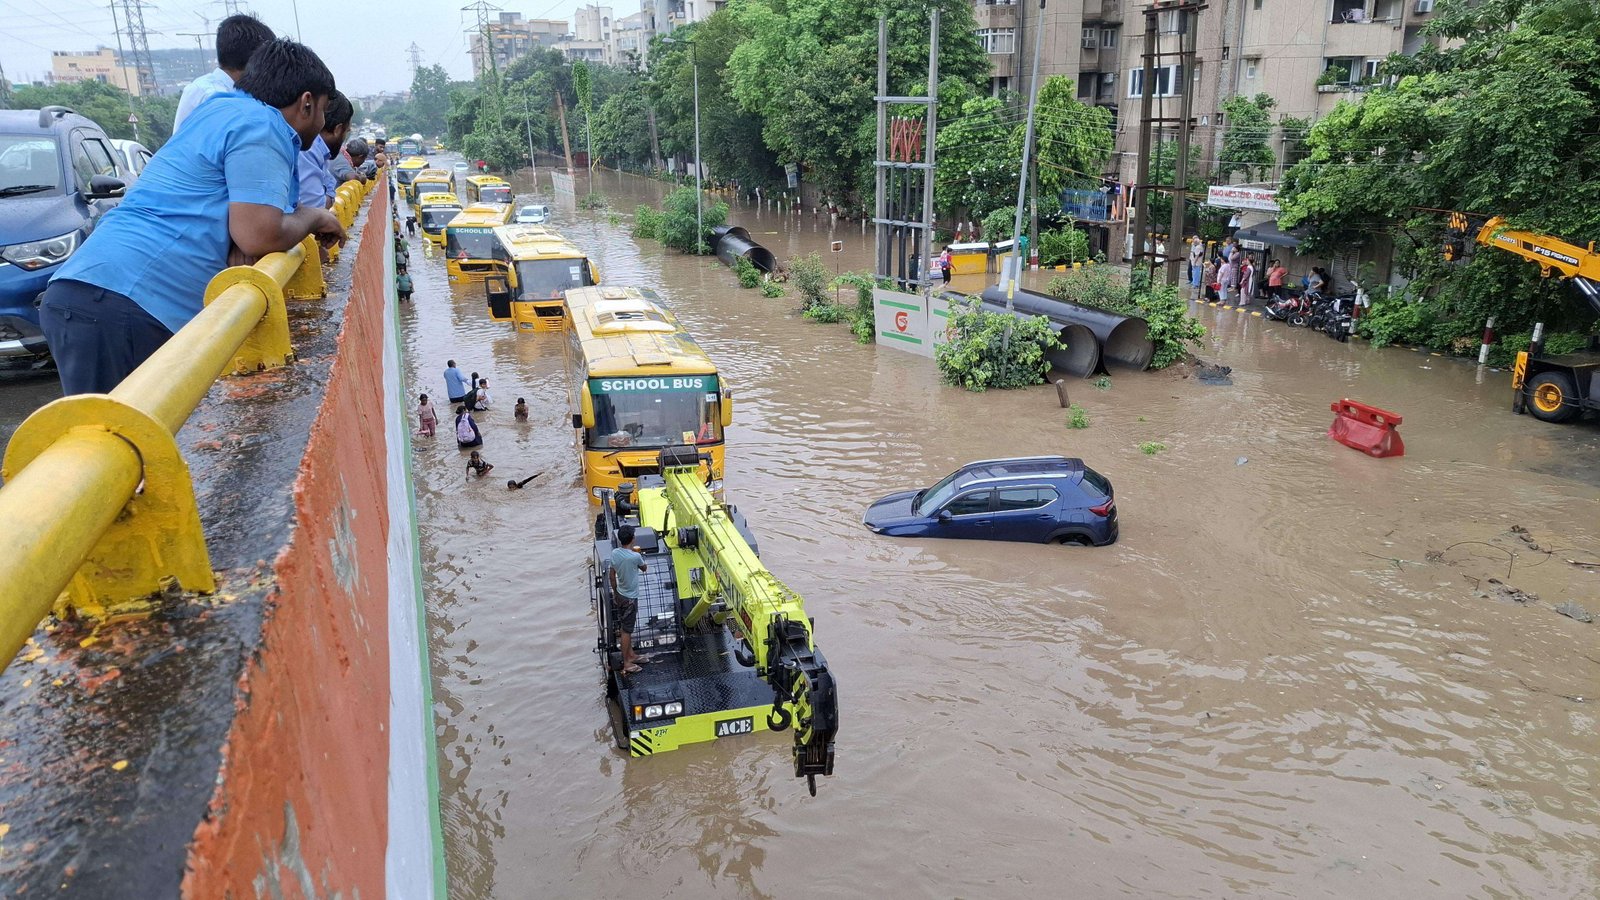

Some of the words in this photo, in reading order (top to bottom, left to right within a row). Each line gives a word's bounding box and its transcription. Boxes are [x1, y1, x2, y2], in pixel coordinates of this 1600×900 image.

[1534, 246, 1551, 257] F15
[1550, 251, 1578, 265] FIGHTER
[601, 379, 669, 392] SCHOOL
[673, 378, 703, 389] BUS
[639, 640, 654, 648] ACE
[718, 719, 751, 736] ACE
